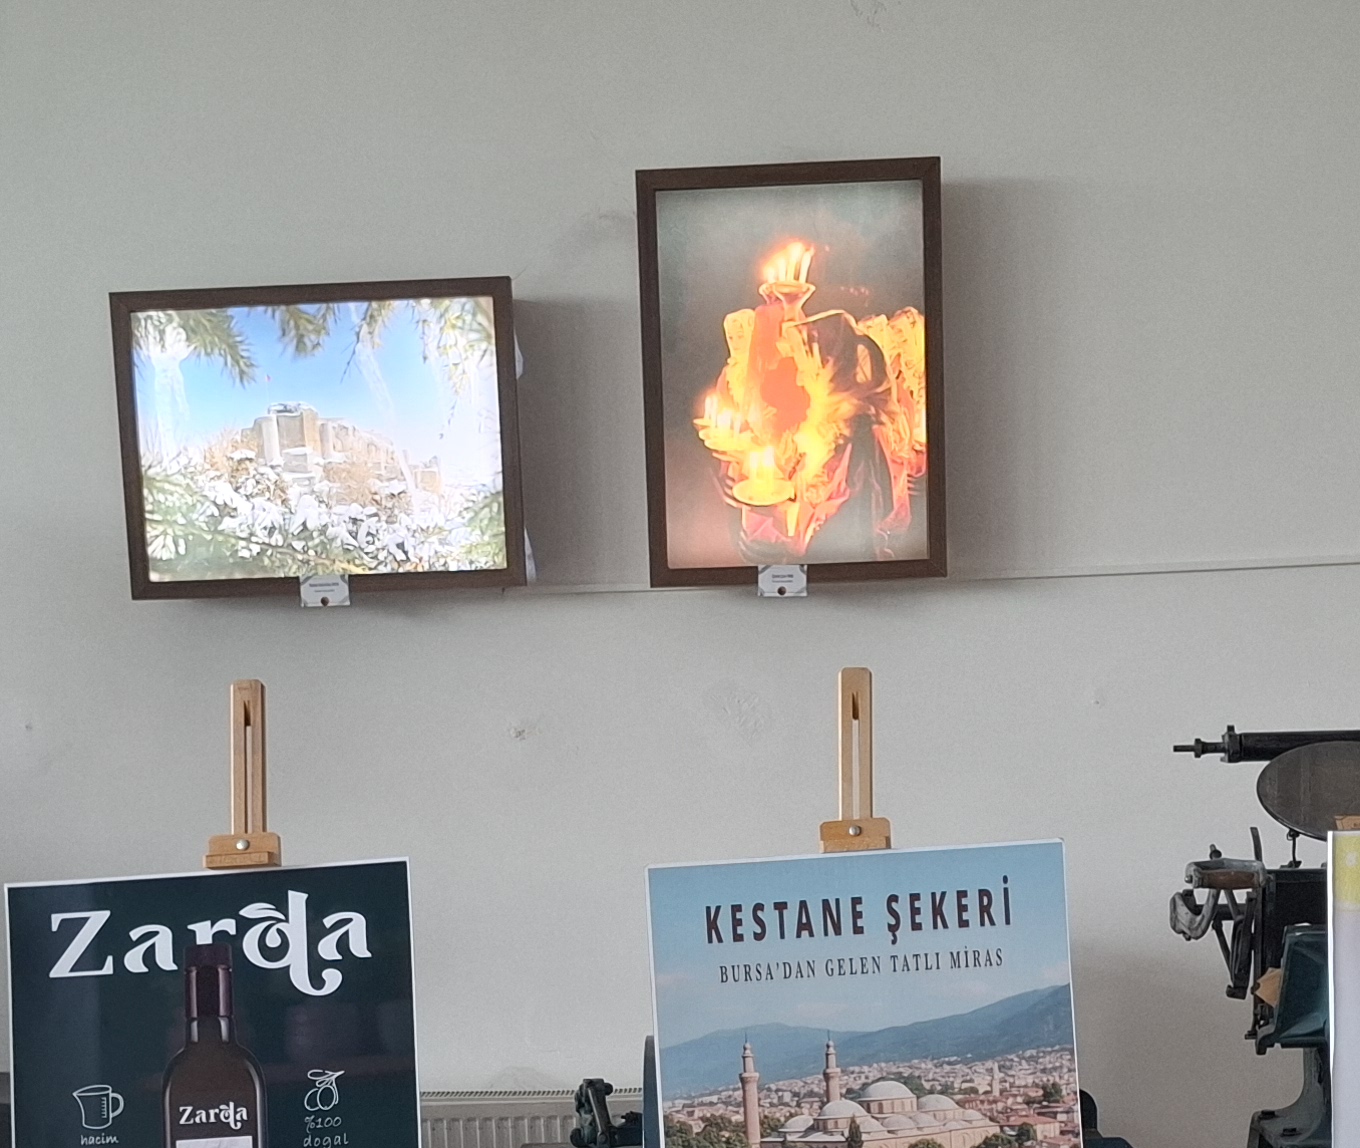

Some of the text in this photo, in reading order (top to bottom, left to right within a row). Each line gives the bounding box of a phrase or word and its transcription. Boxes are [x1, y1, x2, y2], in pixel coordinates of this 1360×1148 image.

[705, 874, 1011, 945] KESTANE ŞEKERİ
[48, 890, 372, 997] Zarda
[719, 945, 1004, 983] BURSA'DAN GELEN TATLI MİRAS
[179, 1101, 248, 1130] Zarda
[304, 1115, 342, 1133] %100
[80, 1132, 119, 1145] hacim
